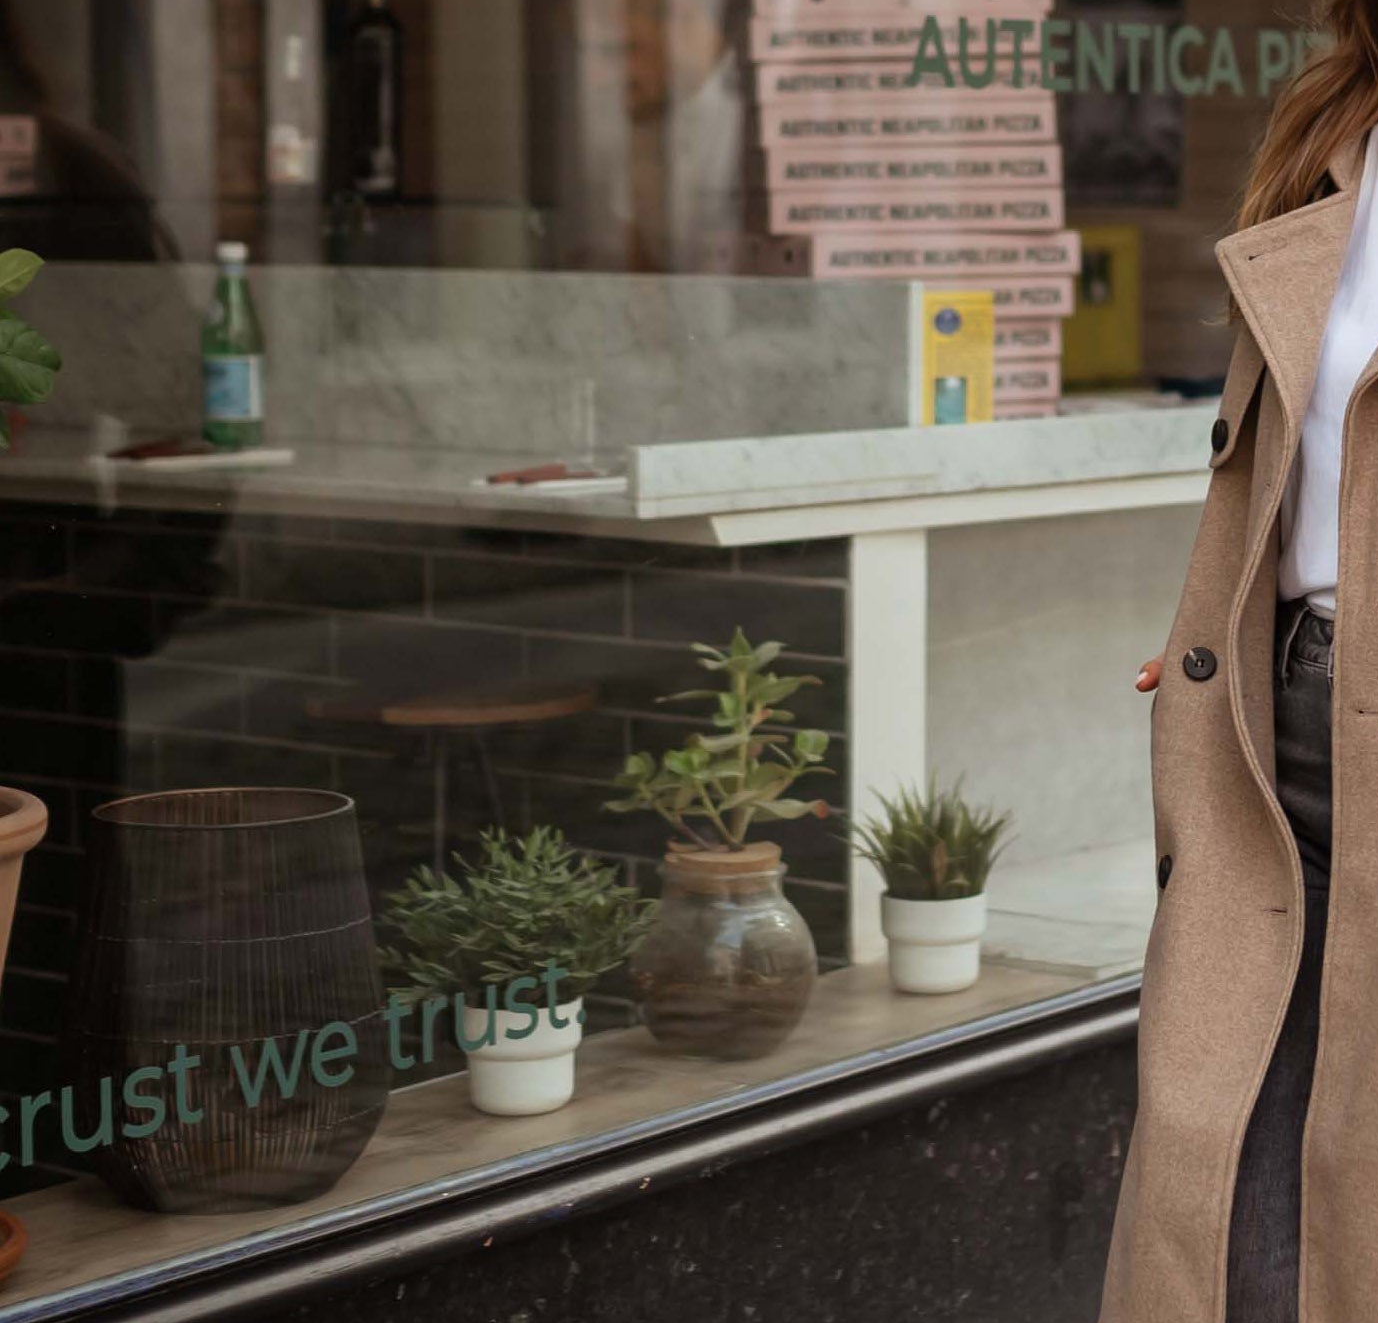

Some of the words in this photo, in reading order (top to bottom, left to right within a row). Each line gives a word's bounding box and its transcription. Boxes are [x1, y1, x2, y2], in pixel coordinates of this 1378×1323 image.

[904, 14, 1245, 97] AUTENTICA
[993, 113, 1041, 132] PIZZA
[786, 160, 882, 180] AUTHENTIC
[999, 156, 1046, 176] PIZZA
[788, 203, 884, 222] AUTHENTIC
[1002, 200, 1050, 219] PIZZA
[829, 248, 917, 267] AUTHENTIC
[1025, 245, 1068, 263] PIZZA
[229, 1020, 359, 1109] we
[382, 958, 588, 1071] trust.
